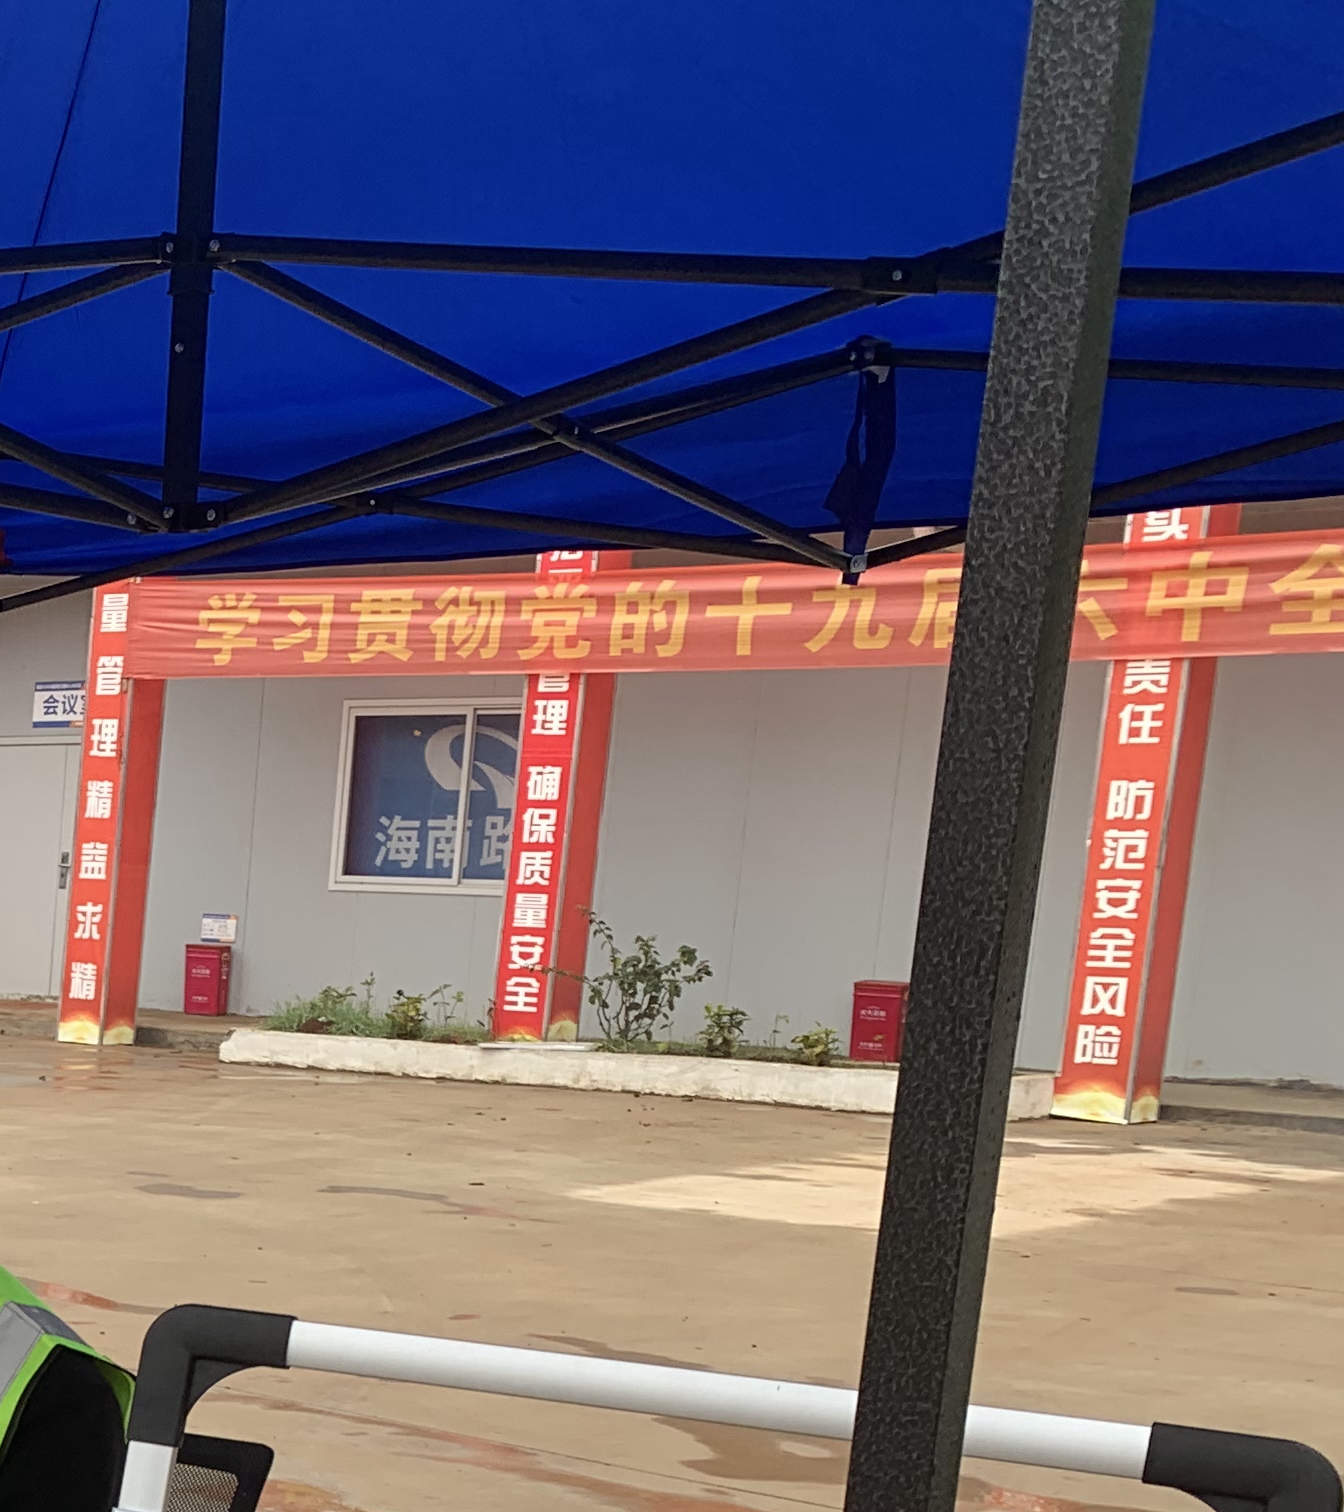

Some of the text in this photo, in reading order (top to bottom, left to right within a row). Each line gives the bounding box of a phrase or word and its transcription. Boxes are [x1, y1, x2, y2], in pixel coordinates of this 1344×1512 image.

[68, 593, 129, 1001] 量管理精益求精
